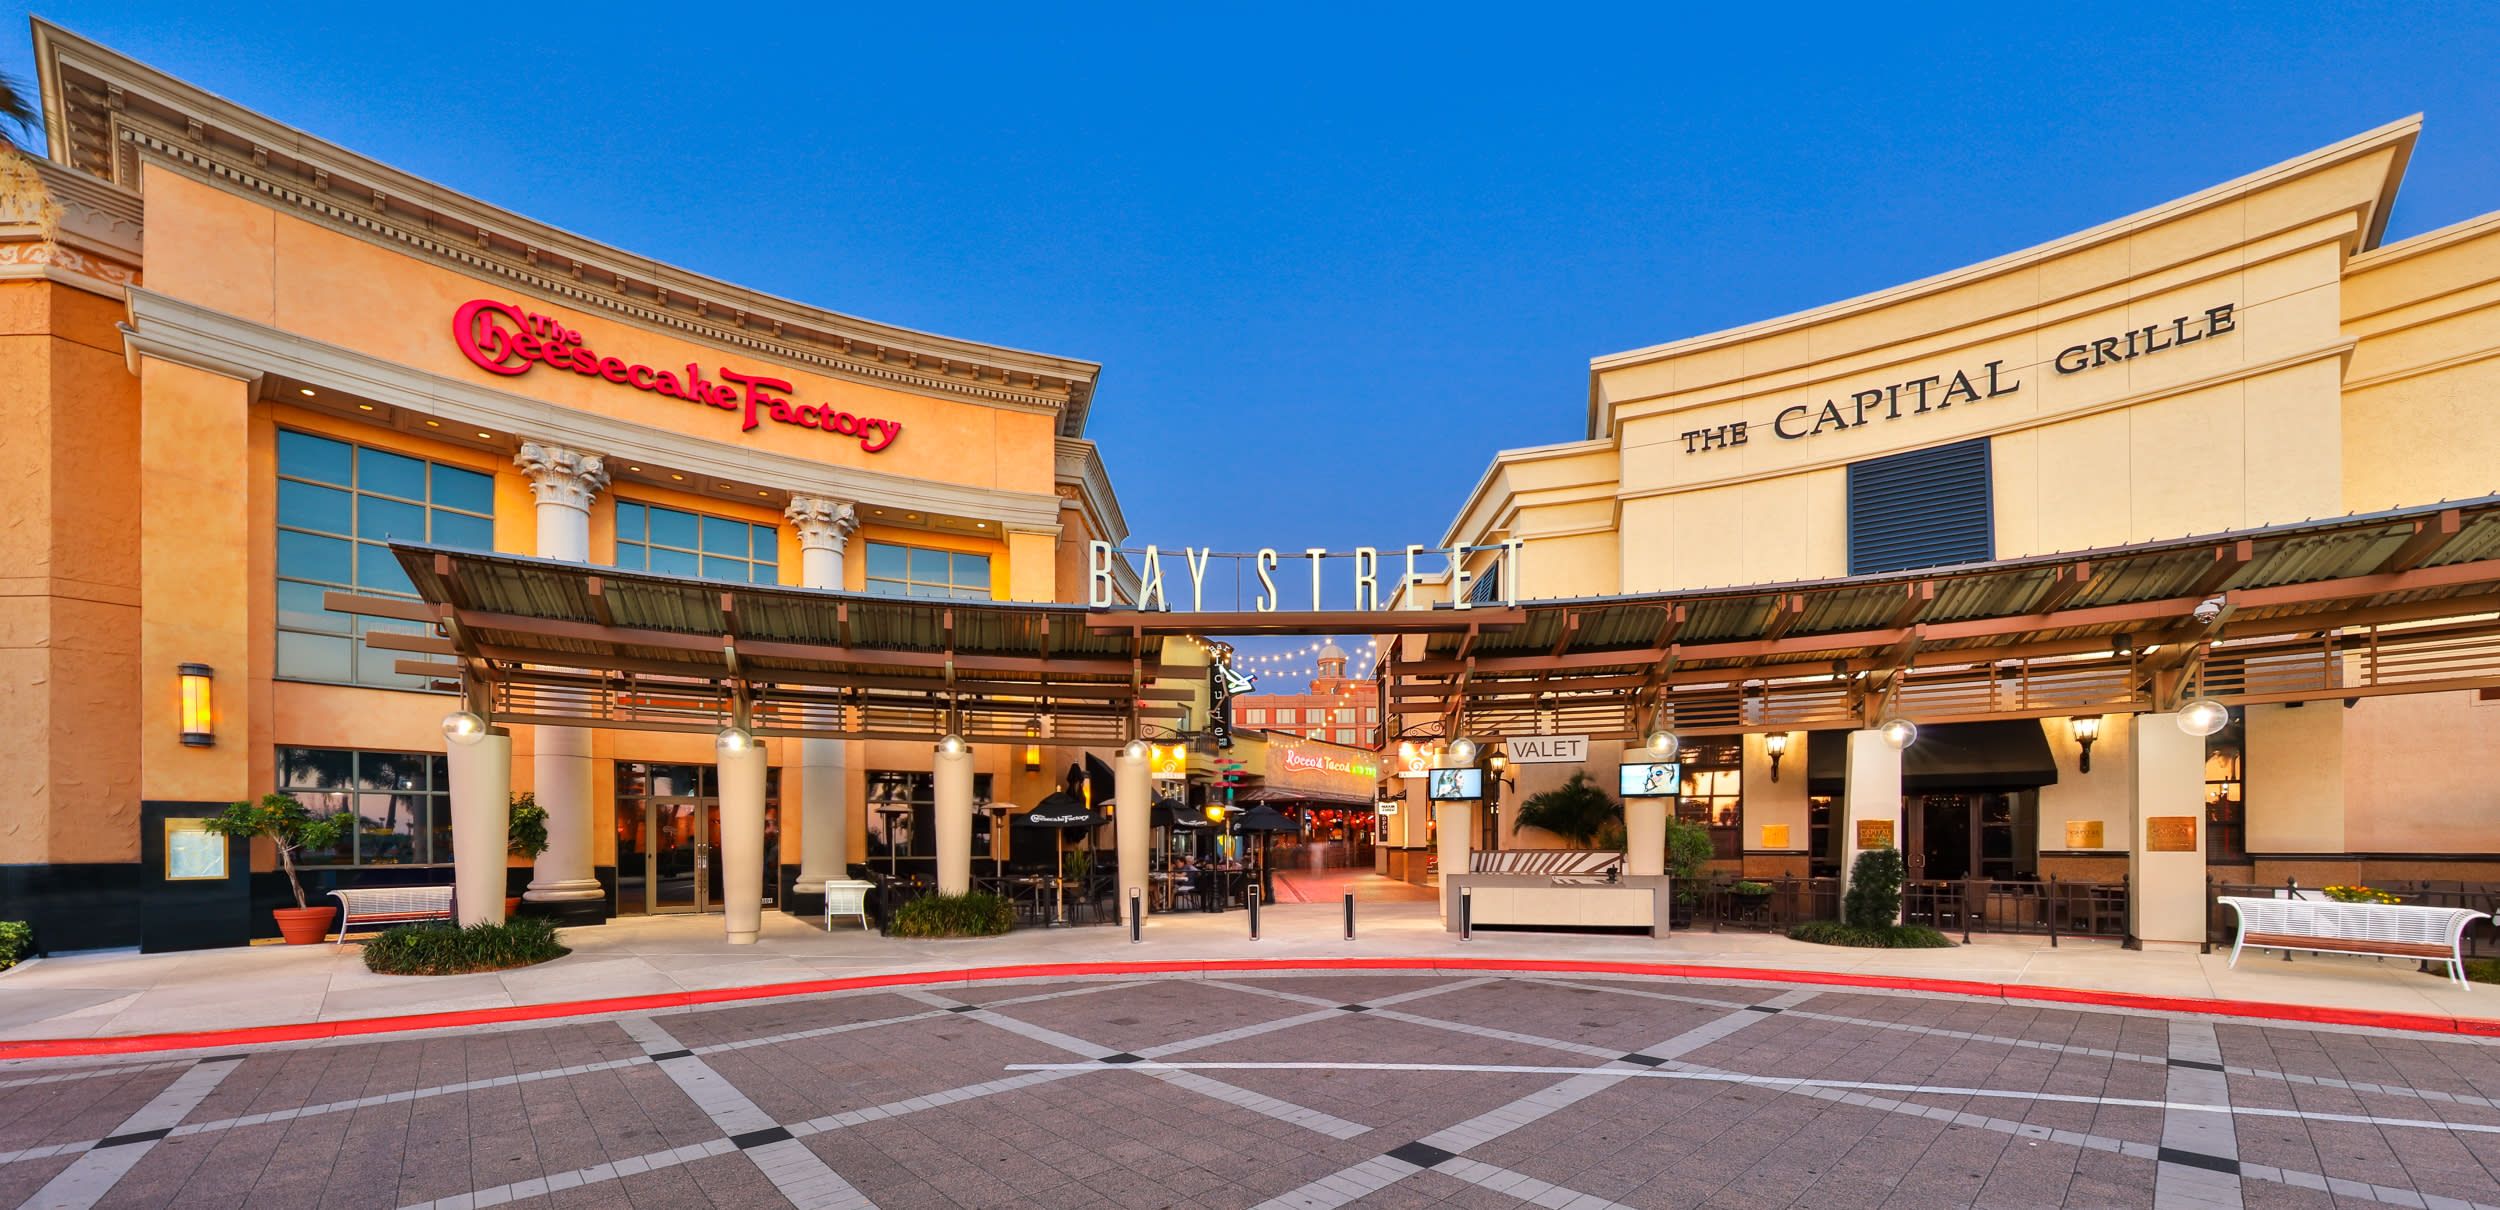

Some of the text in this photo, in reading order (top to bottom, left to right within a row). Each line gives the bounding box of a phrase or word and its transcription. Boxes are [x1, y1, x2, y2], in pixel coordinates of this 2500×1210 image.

[528, 311, 582, 345] The
[453, 298, 902, 454] Cheesecake Factory
[1681, 303, 2236, 454] THE CAPITAL GRILLE
[1089, 537, 1525, 612] BAY STREET
[1209, 643, 1230, 657] Bar
[1286, 749, 1323, 769] Rocco's
[1324, 756, 1350, 773] Tacos
[1513, 740, 1581, 758] VALET
